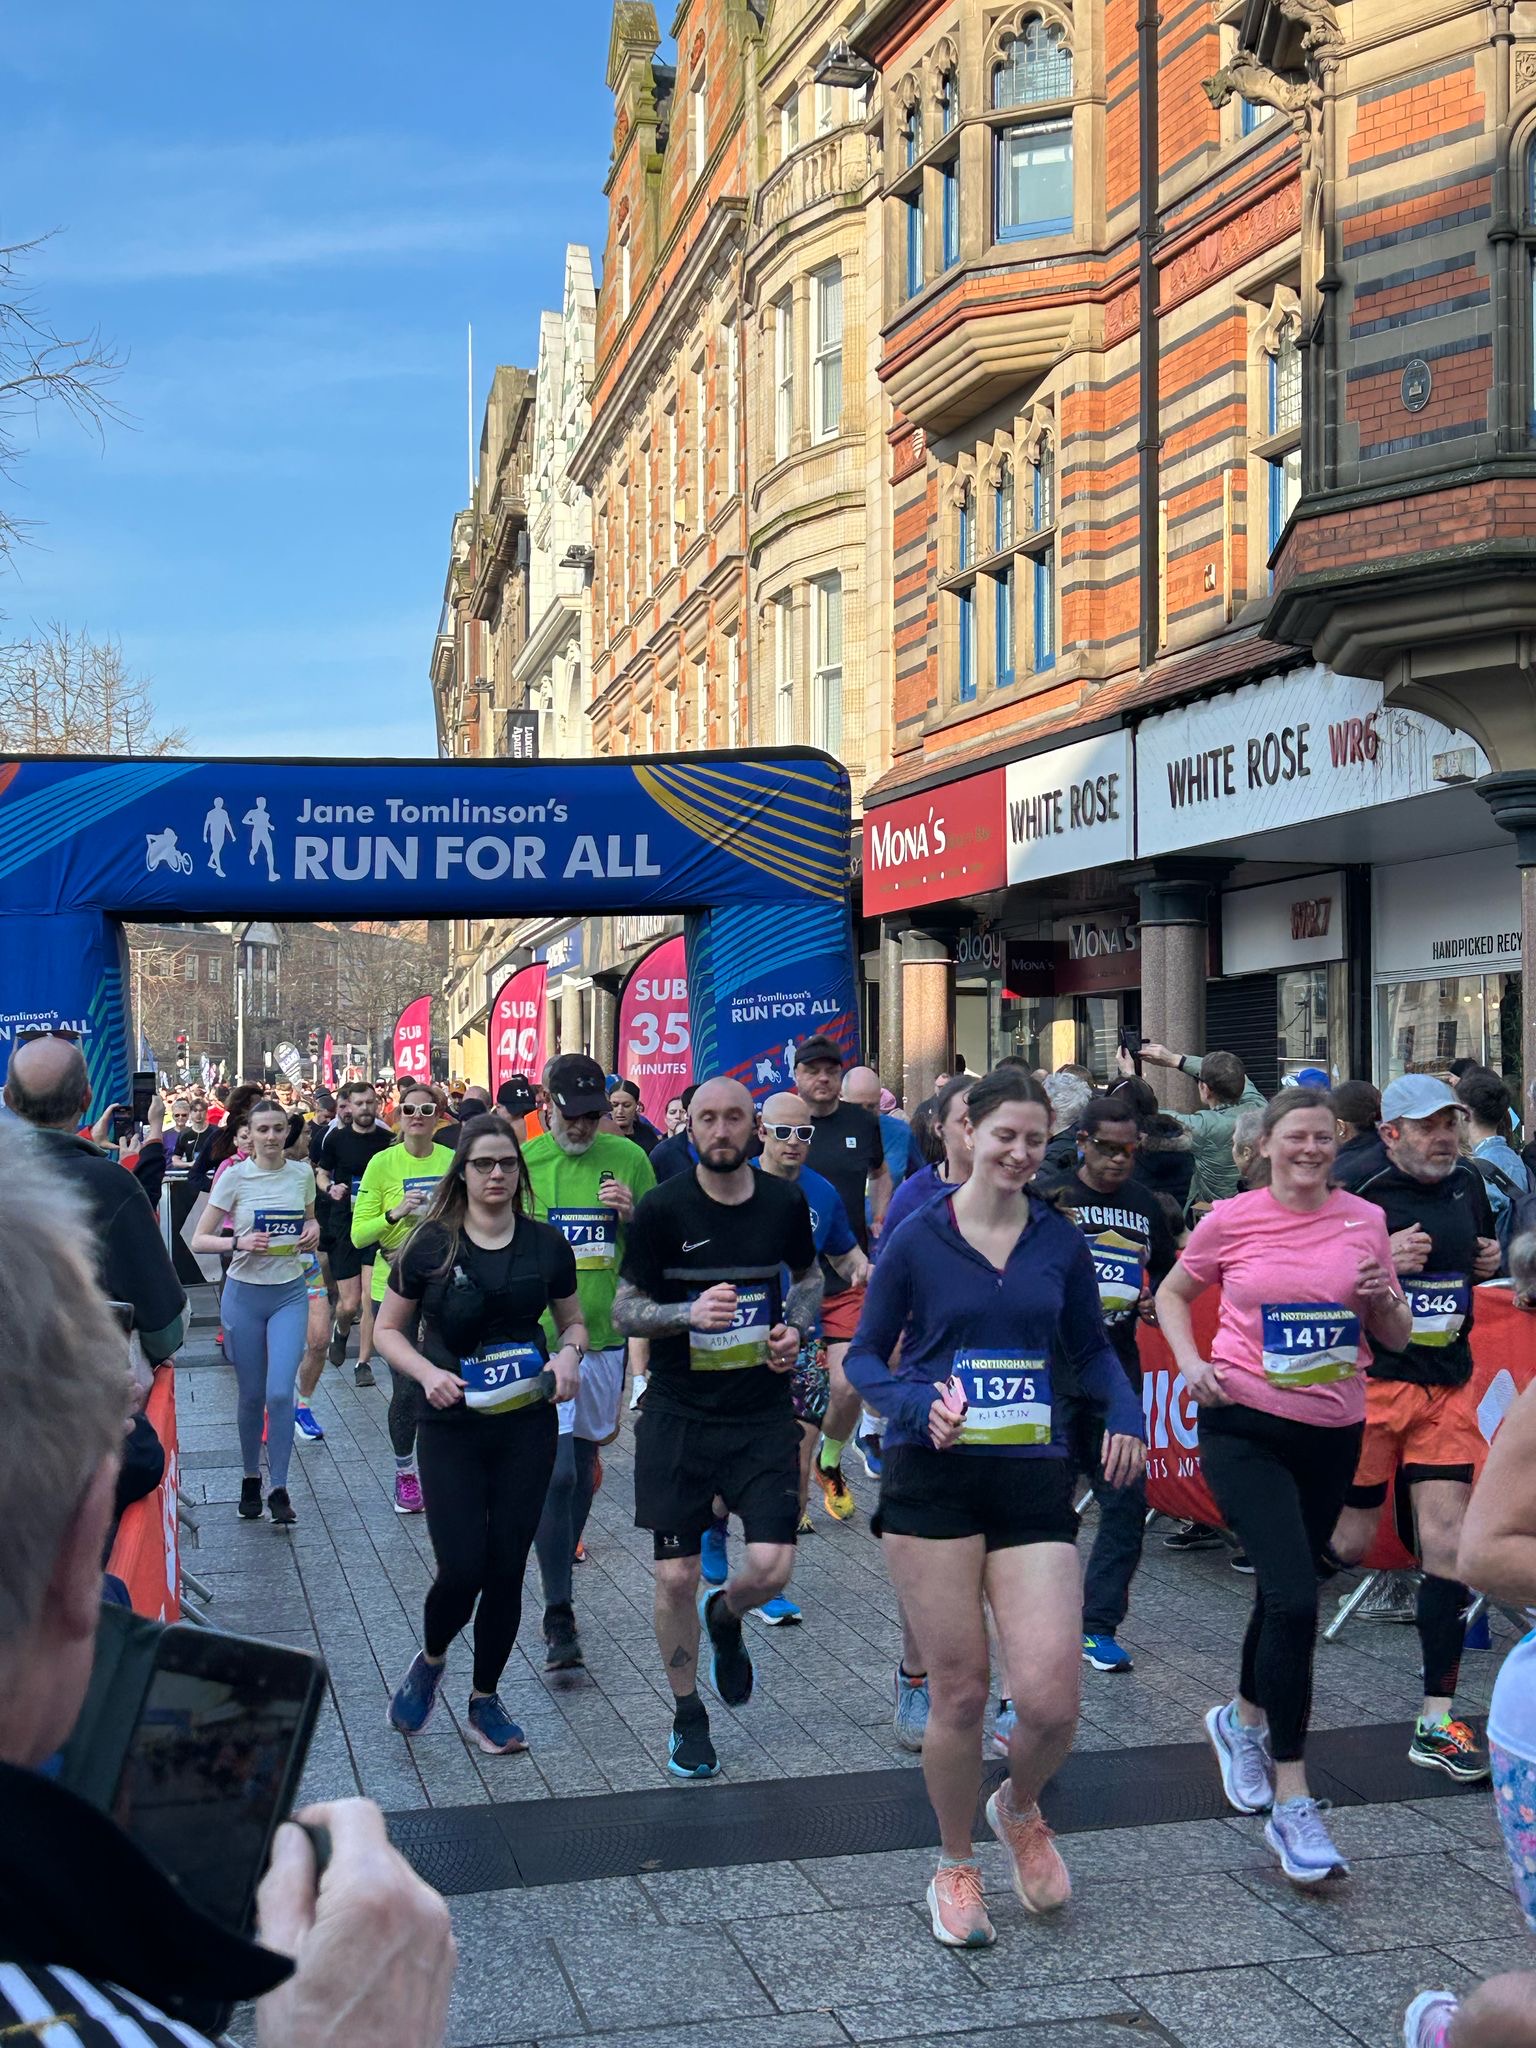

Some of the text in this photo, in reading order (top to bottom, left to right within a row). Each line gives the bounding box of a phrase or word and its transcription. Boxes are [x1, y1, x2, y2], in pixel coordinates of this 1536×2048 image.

[1167, 744, 1236, 809] WHITE
[1248, 723, 1311, 789] ROSE
[297, 798, 568, 824] Jane Tomlinson's
[1009, 789, 1063, 844] WHITE
[1070, 773, 1119, 829] ROSE
[294, 833, 661, 881] RUN FOR ALL
[956, 927, 1001, 970] ology
[1433, 935, 1494, 960] HANDPICKED
[634, 978, 688, 1001] SUB
[731, 990, 812, 1006] Jane Tomlinson's
[501, 1001, 538, 1019] SUB
[732, 998, 841, 1023] RUN FOR ALL
[398, 1024, 422, 1040] SUB
[629, 1012, 690, 1056] 35
[398, 1043, 428, 1071] 45
[496, 1027, 538, 1063] 40
[629, 1063, 687, 1075] MINUTES
[264, 1223, 297, 1235] 1256
[562, 1225, 605, 1241] 1718
[1283, 1326, 1346, 1348] 1417
[483, 1362, 521, 1385] 371
[973, 1376, 1036, 1401] 1375
